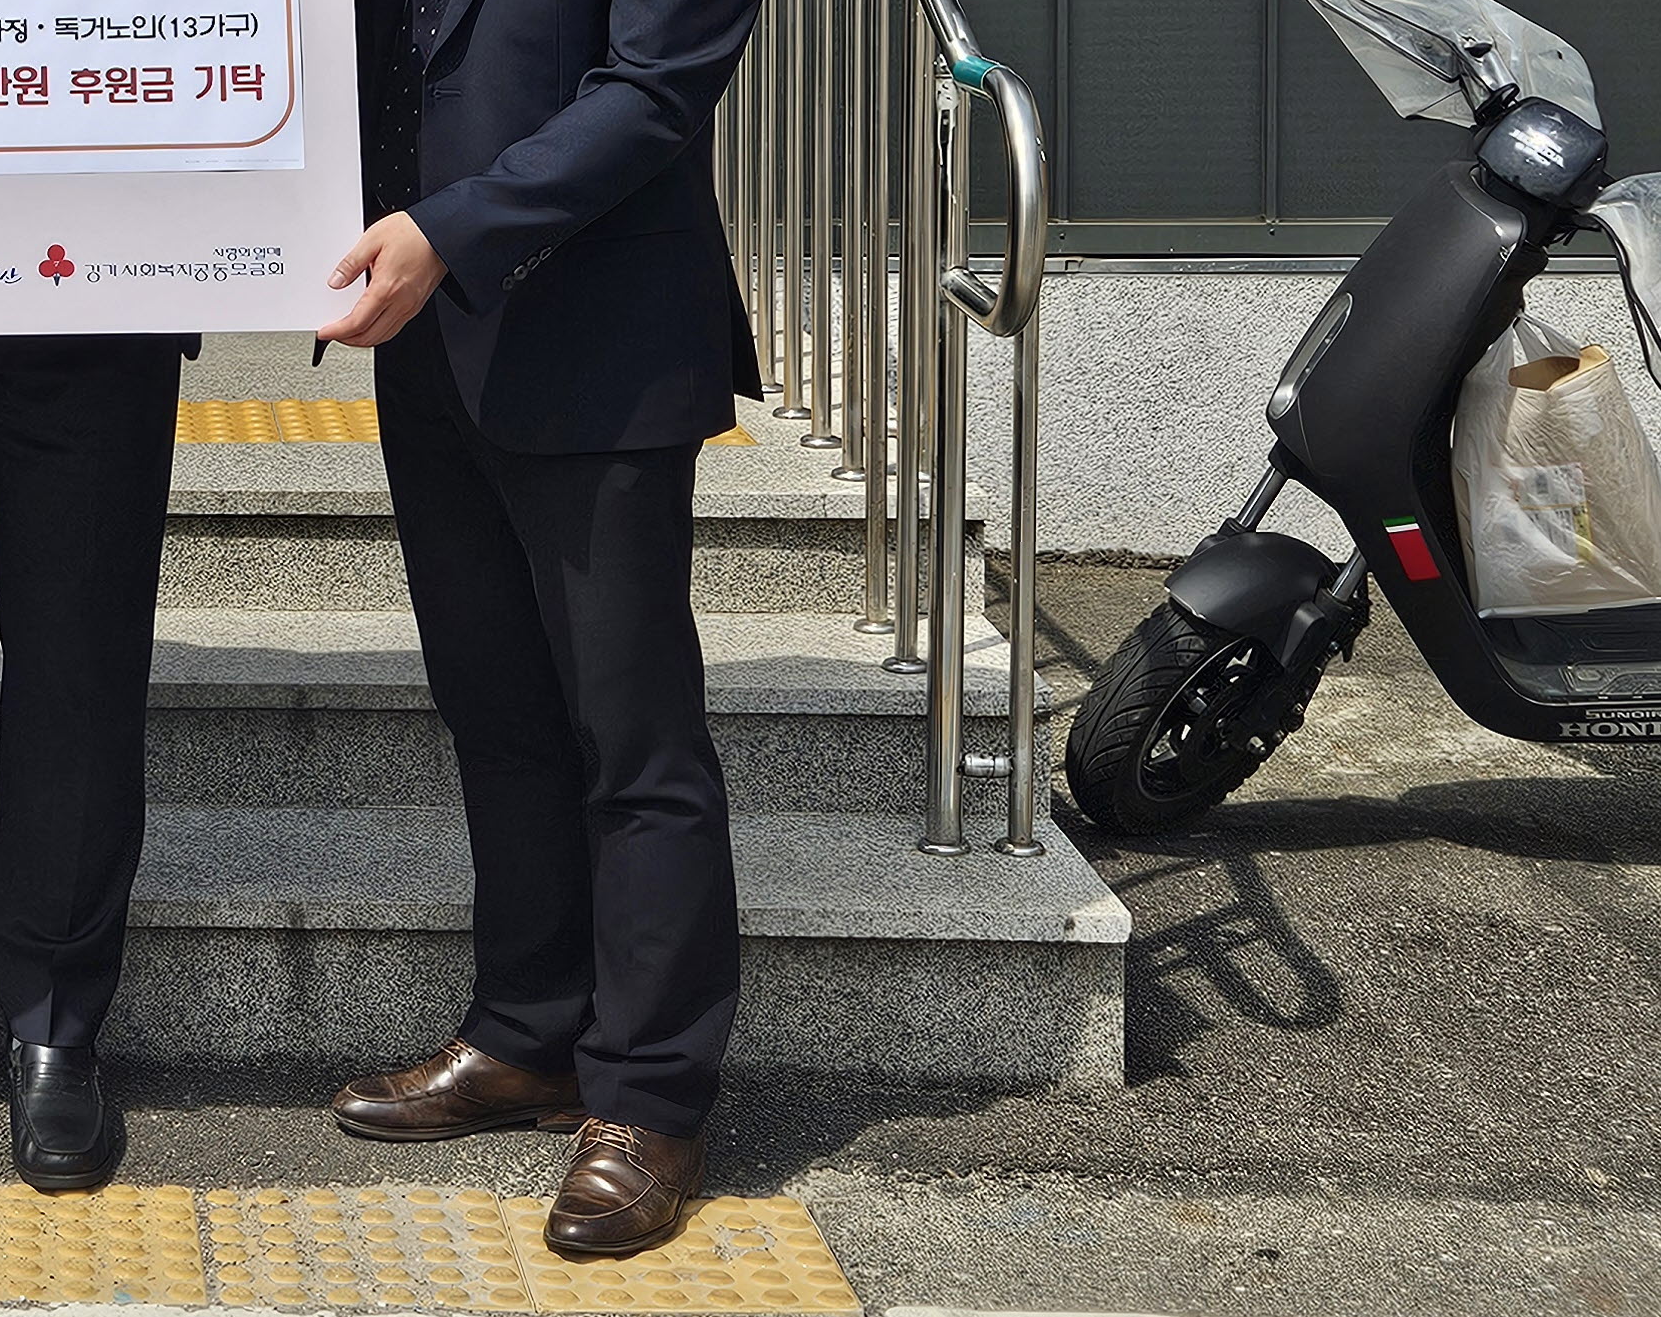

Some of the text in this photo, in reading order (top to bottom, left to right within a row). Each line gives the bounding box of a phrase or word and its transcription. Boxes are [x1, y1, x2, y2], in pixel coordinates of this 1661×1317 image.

[54, 12, 260, 42] 독거노인(13가구)
[69, 65, 174, 105] 후원금
[195, 63, 266, 102] 기탁
